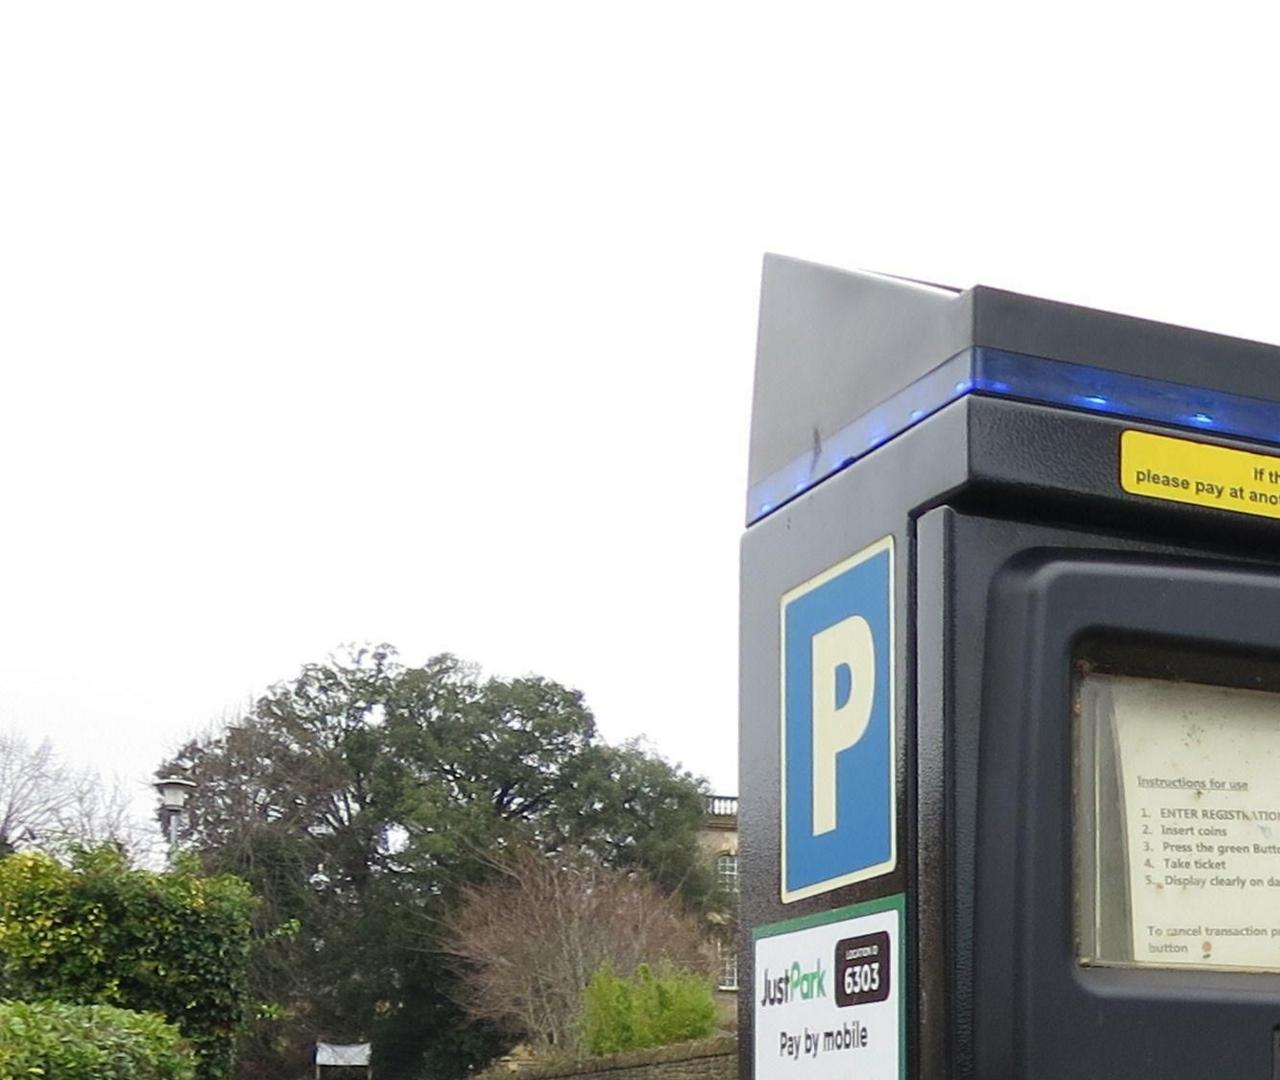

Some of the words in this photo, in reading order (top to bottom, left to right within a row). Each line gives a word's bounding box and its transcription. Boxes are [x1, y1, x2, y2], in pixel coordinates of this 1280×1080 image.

[1254, 467, 1264, 482] If
[1136, 470, 1190, 490] please
[1194, 481, 1224, 499] pay
[1229, 486, 1244, 500] at
[812, 615, 875, 836] P
[1138, 776, 1206, 789] Instructions
[1208, 778, 1226, 790] for
[1228, 780, 1248, 792] use
[1160, 807, 1198, 819] ENTER
[1160, 824, 1195, 836] Insert
[1197, 825, 1227, 836] coins
[1162, 841, 1192, 852] Press
[1195, 841, 1214, 853] the
[1216, 844, 1250, 856] green
[1163, 858, 1191, 869] Take
[1193, 858, 1226, 870] ticket
[1164, 874, 1207, 889] Display
[1209, 875, 1246, 889] clearly
[1249, 878, 1264, 887] on
[760, 958, 826, 1007] JustPark
[844, 962, 879, 994] 6303
[780, 1031, 801, 1060] Pay
[804, 1028, 819, 1058] by
[823, 1020, 868, 1051] mobile
